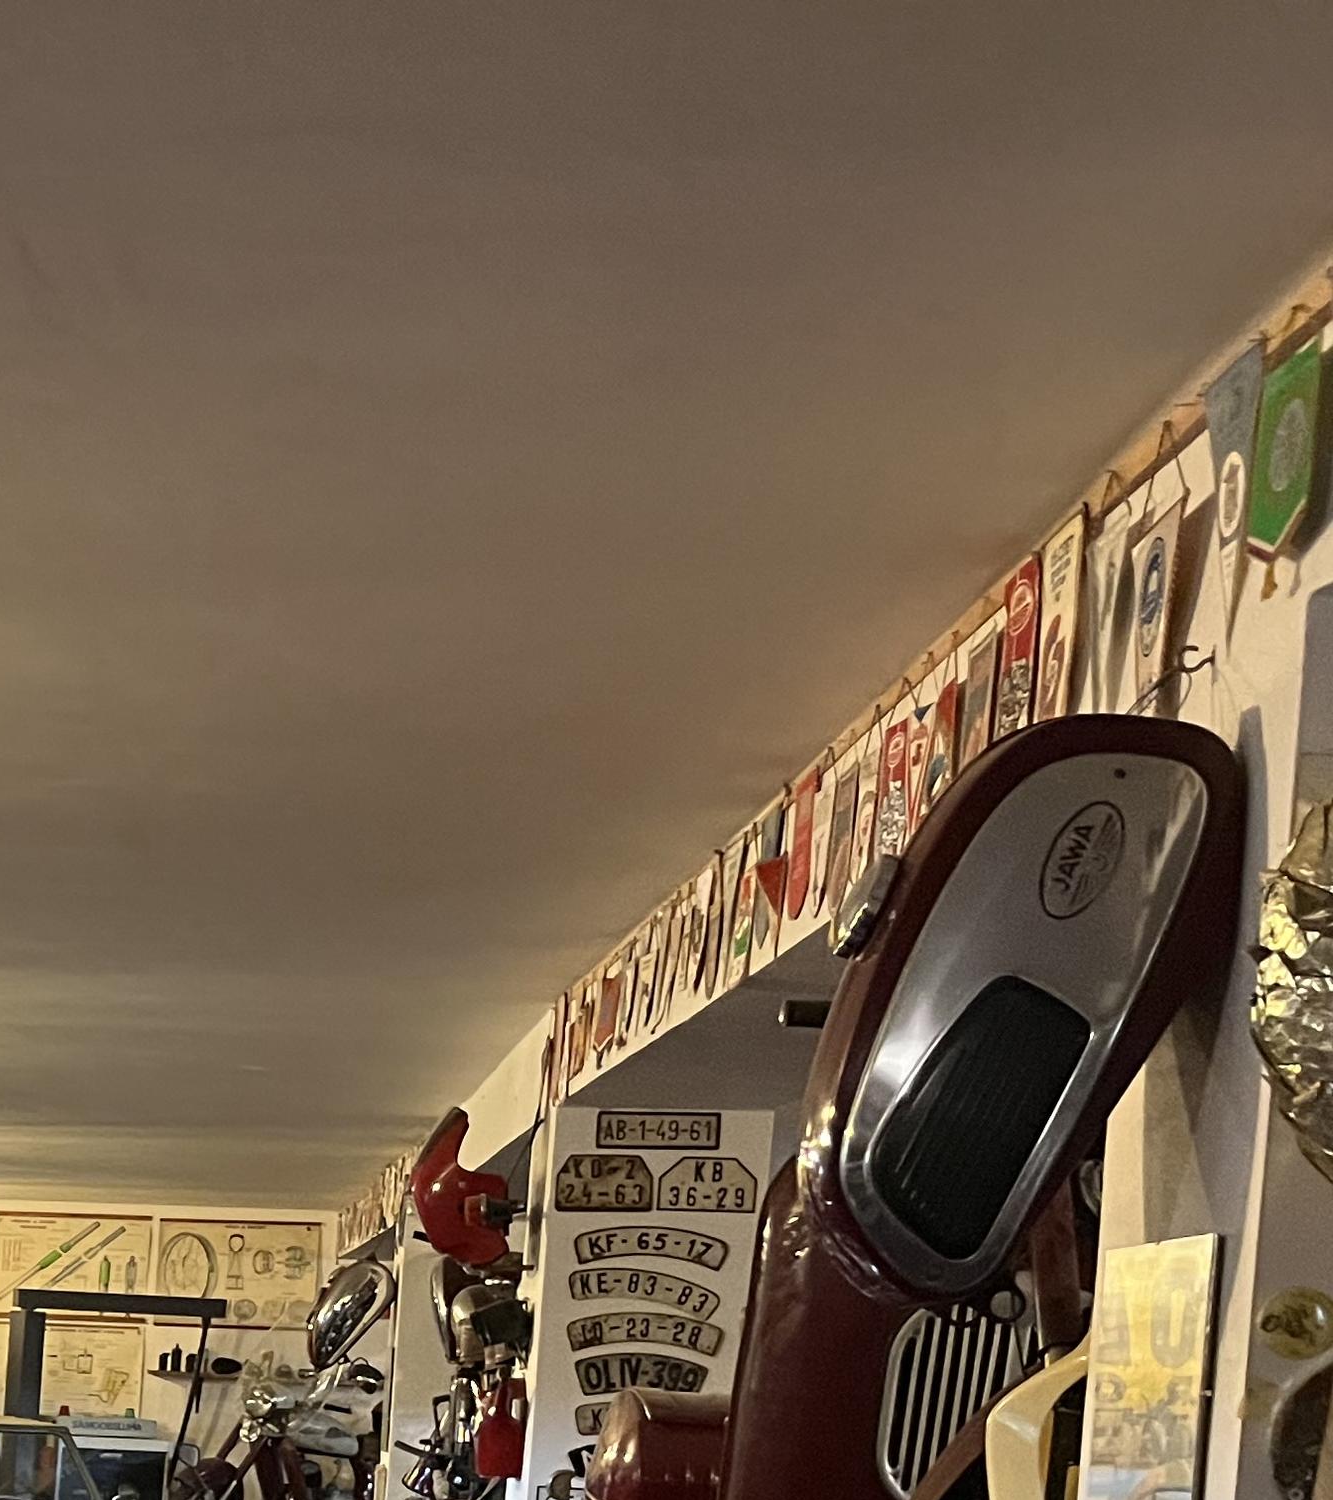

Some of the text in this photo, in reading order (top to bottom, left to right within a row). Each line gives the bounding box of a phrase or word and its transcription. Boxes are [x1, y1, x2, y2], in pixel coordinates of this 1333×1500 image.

[1052, 825, 1095, 892] JAWA
[603, 1119, 713, 1142] AB-1-49-61
[693, 1161, 724, 1183] KB
[668, 1187, 746, 1209] 36-29
